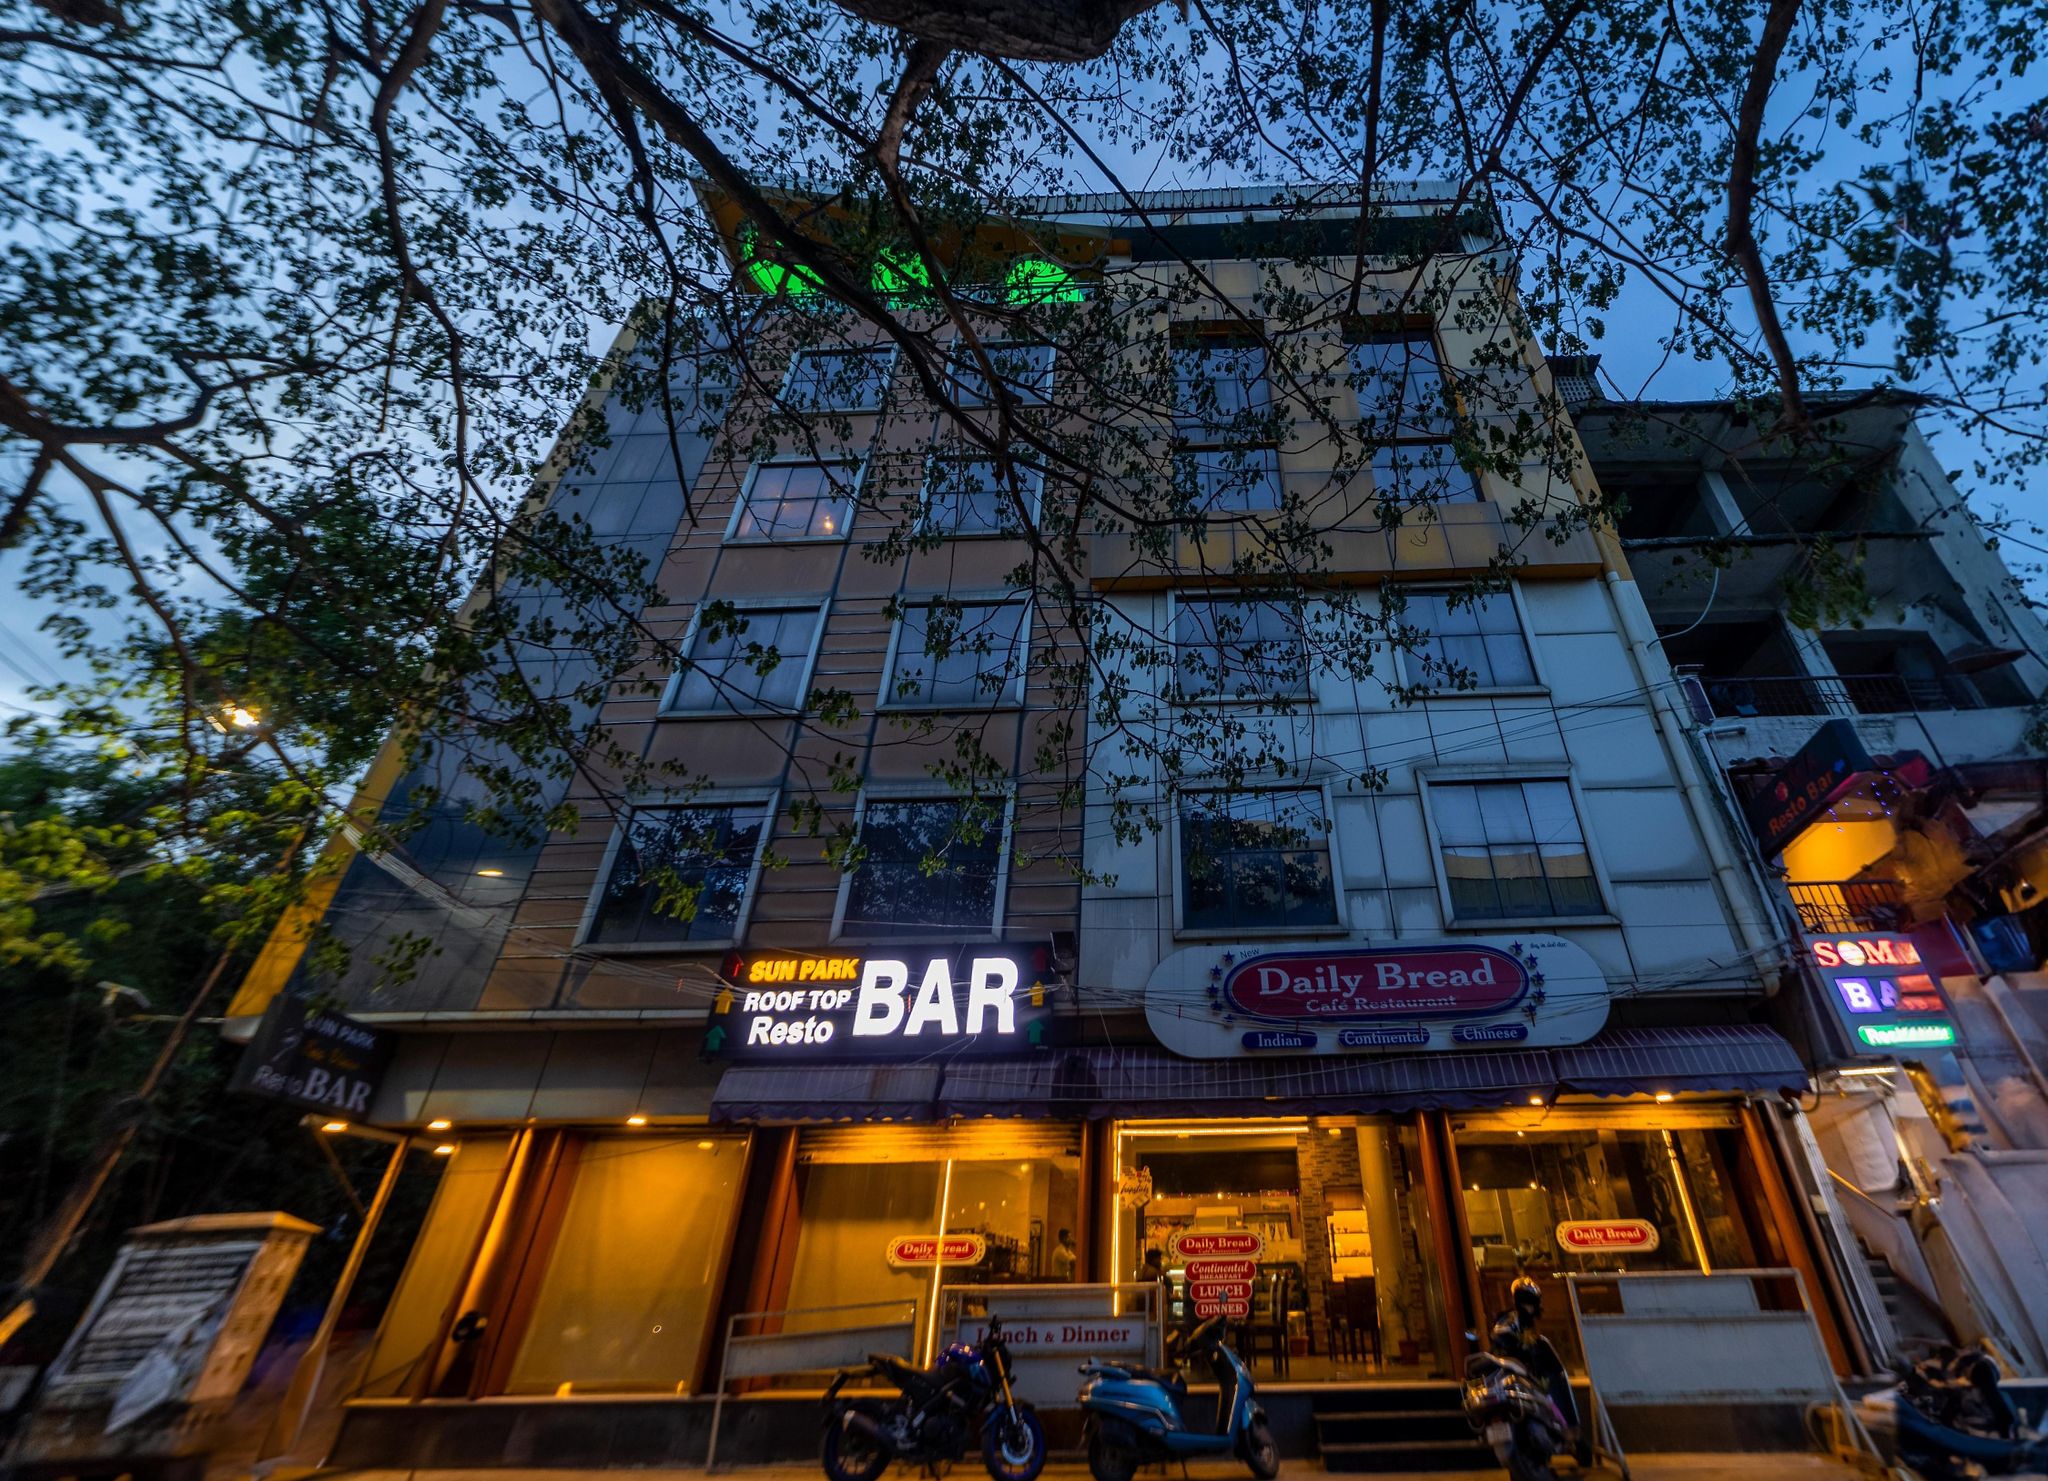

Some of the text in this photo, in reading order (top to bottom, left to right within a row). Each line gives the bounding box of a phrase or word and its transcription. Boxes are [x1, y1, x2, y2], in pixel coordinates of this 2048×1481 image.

[1768, 770, 1833, 837] Resto Bar
[1239, 948, 1259, 959] New
[749, 958, 860, 983] SUN PARK
[1257, 958, 1496, 998] Daily Bread
[743, 989, 853, 1013] ROOF TOP
[852, 957, 1018, 1037] BAR
[1354, 995, 1457, 1011] Restaurant
[747, 1016, 834, 1046] Resto
[1344, 1028, 1425, 1046] Continental
[1463, 1026, 1519, 1041] Chinese
[1257, 1032, 1302, 1048] Indian
[301, 1066, 373, 1113] BAR
[1572, 1227, 1641, 1241] Daily Bread
[904, 1242, 969, 1255] Daily read
[1185, 1236, 1252, 1250] Daily Bread
[1191, 1260, 1250, 1275] Continental
[1200, 1284, 1243, 1297] LUNCH
[1200, 1303, 1243, 1315] DINNER
[976, 1325, 1131, 1343] Lnch & Dinner
